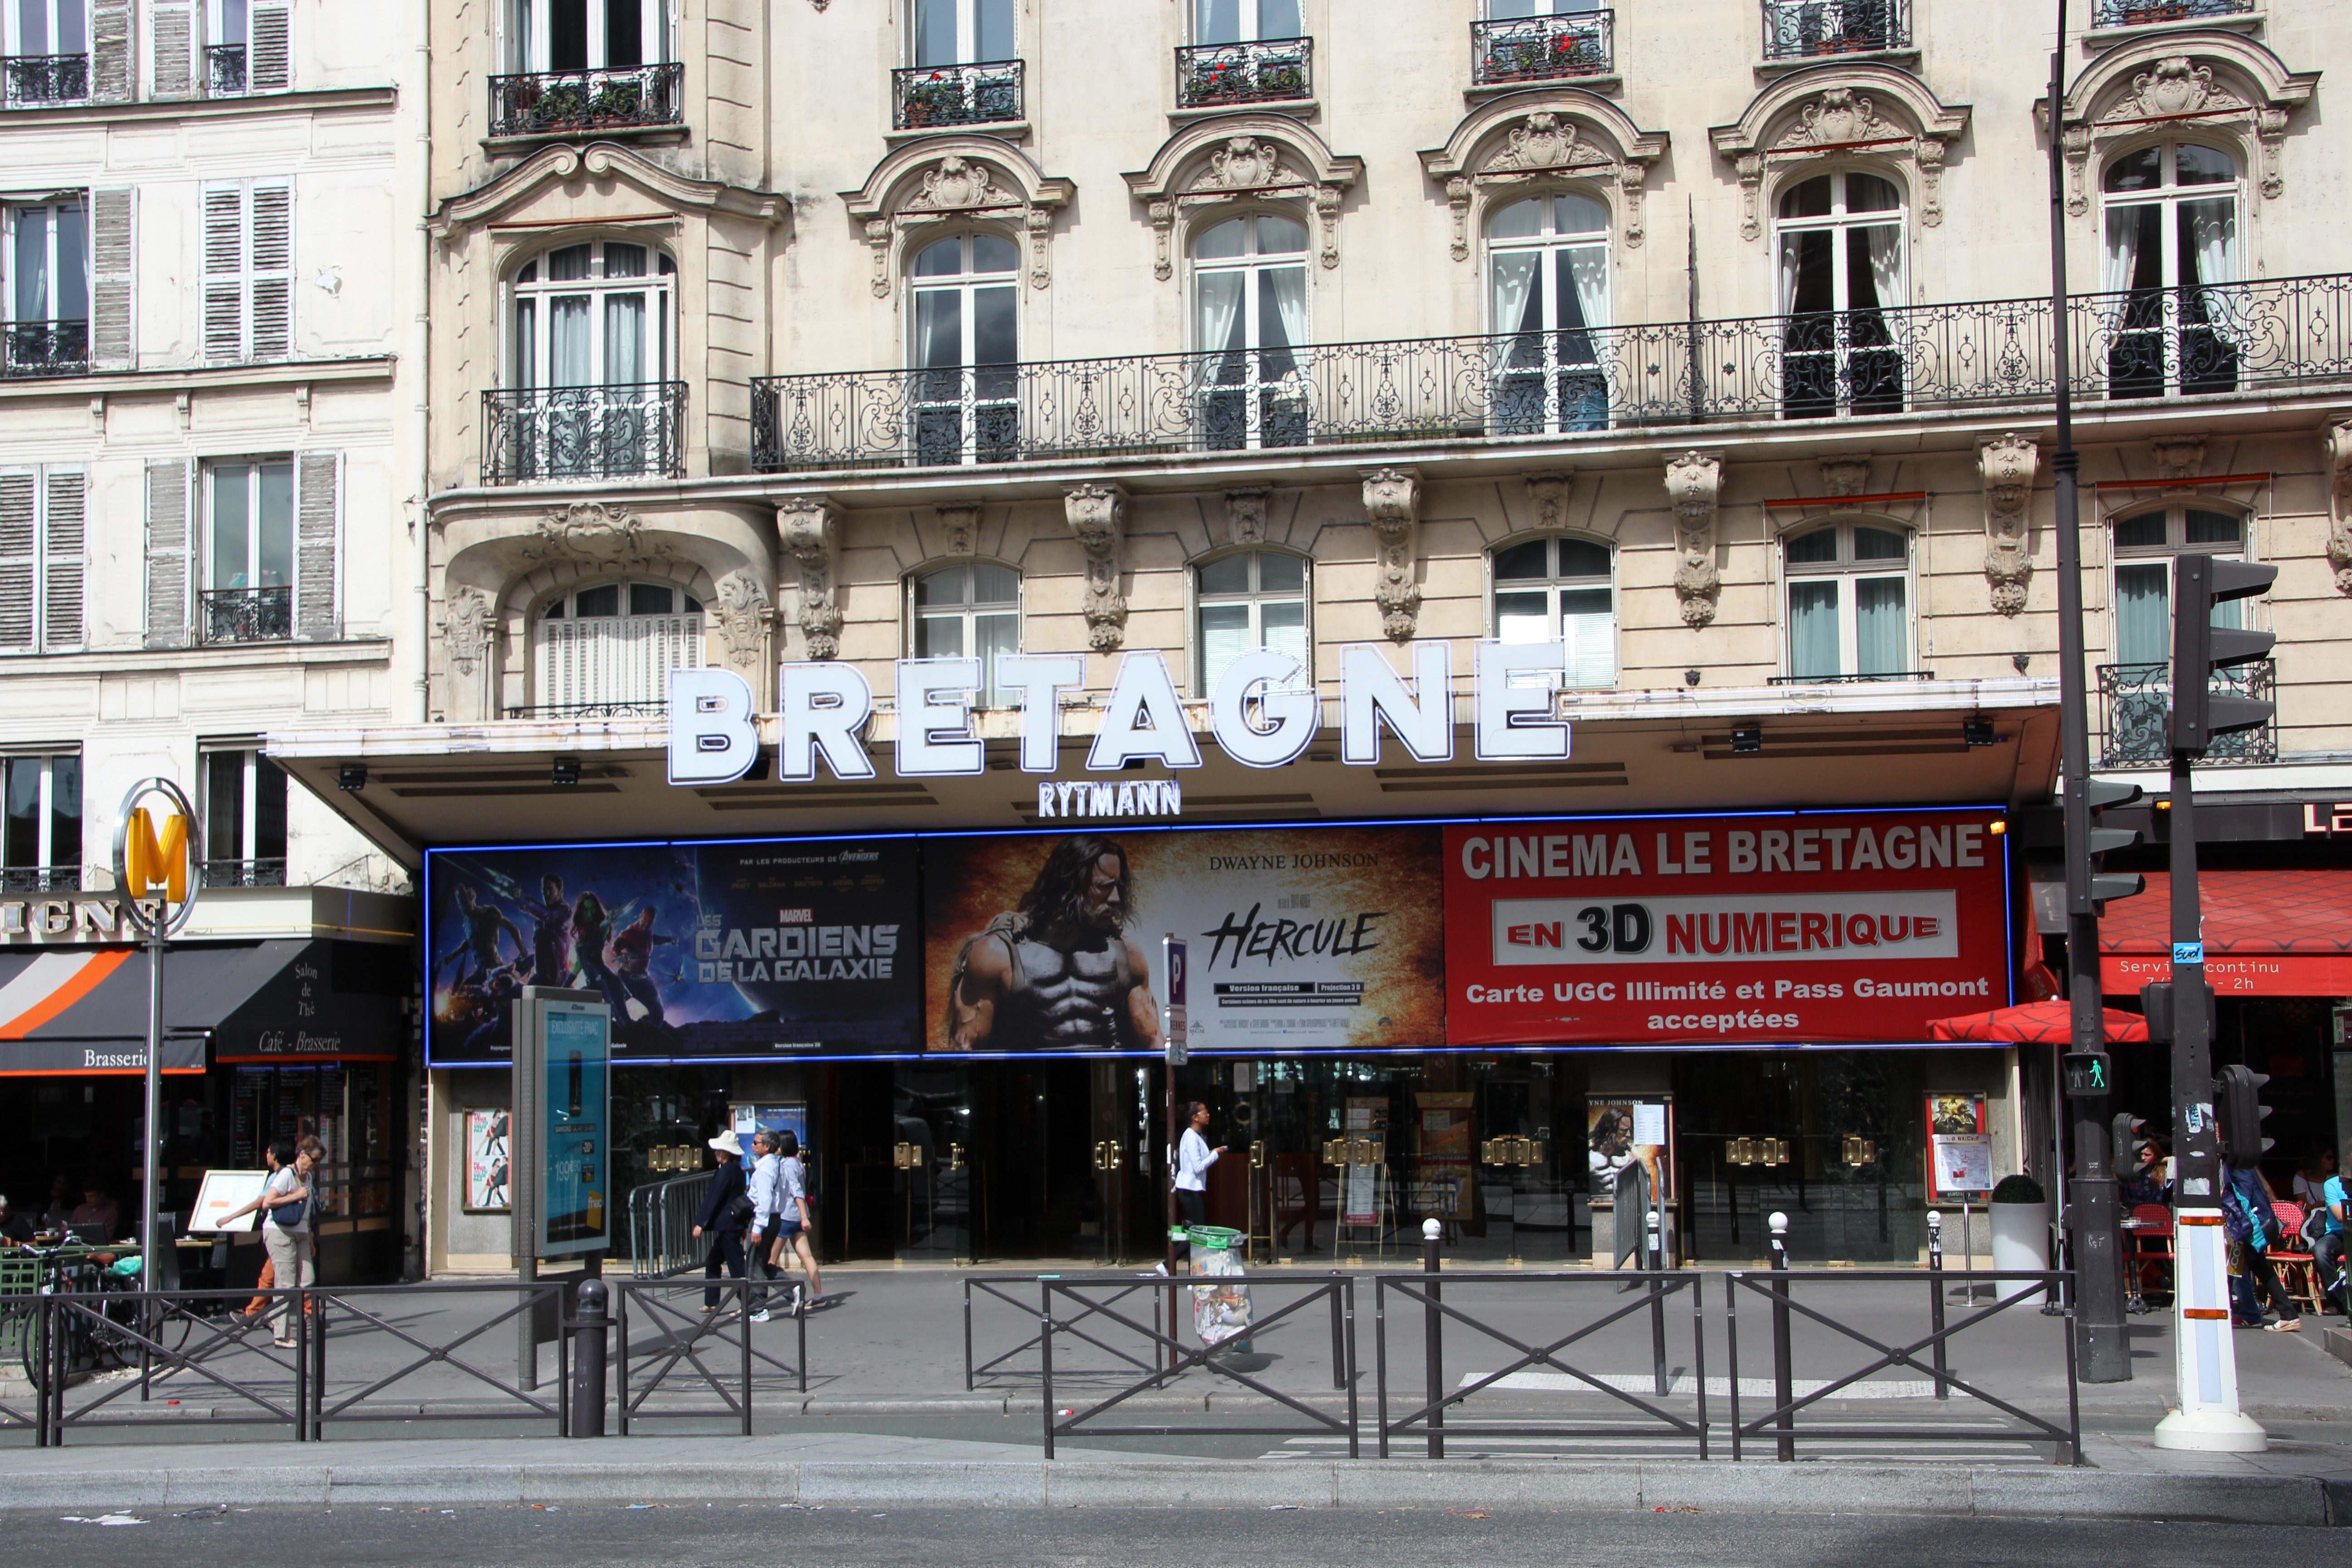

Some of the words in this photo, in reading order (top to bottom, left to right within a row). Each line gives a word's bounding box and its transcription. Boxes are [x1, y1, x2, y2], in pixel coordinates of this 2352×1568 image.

[668, 636, 1571, 786] BRETAGNE
[1039, 780, 1181, 817] RYTMANN
[127, 808, 187, 903] M
[839, 850, 880, 863] AVENGERS
[1462, 833, 1642, 879] CINEMA
[1657, 831, 1711, 874] LE
[1728, 824, 1984, 872] BRETAGNE
[1210, 855, 1285, 870] DWAYNE
[1292, 853, 1379, 868] JOHNSON
[696, 914, 723, 926] LES
[780, 909, 813, 923] MARVEL
[1200, 902, 1390, 973] HERCULE
[1507, 920, 1563, 948] EN
[1576, 903, 1652, 953] 3D
[1665, 912, 1939, 955] NUMERIQUE
[695, 924, 901, 960] GARDIENS
[295, 962, 318, 979] Salon
[698, 960, 733, 983] DE
[738, 961, 770, 982] LA
[774, 957, 893, 982] GALAXIE
[1173, 954, 1181, 995] P
[2205, 960, 2279, 973] continu
[302, 982, 311, 997] de
[1261, 984, 1299, 993] française
[1466, 984, 1544, 1003] Carte
[1553, 982, 1616, 1001] UGC
[1626, 980, 1726, 1001] Illimité
[1735, 980, 1764, 1000] et
[1774, 980, 1843, 999] Pass
[1853, 977, 1989, 998] Gaumont
[2234, 977, 2254, 989] 2h
[299, 1000, 315, 1017] Thé
[1171, 1019, 1186, 1031] RENNES
[1647, 1009, 1799, 1033] acceptées
[259, 1030, 284, 1052] Café
[296, 1030, 340, 1052] Brasserie
[588, 1196, 602, 1208] fnac
